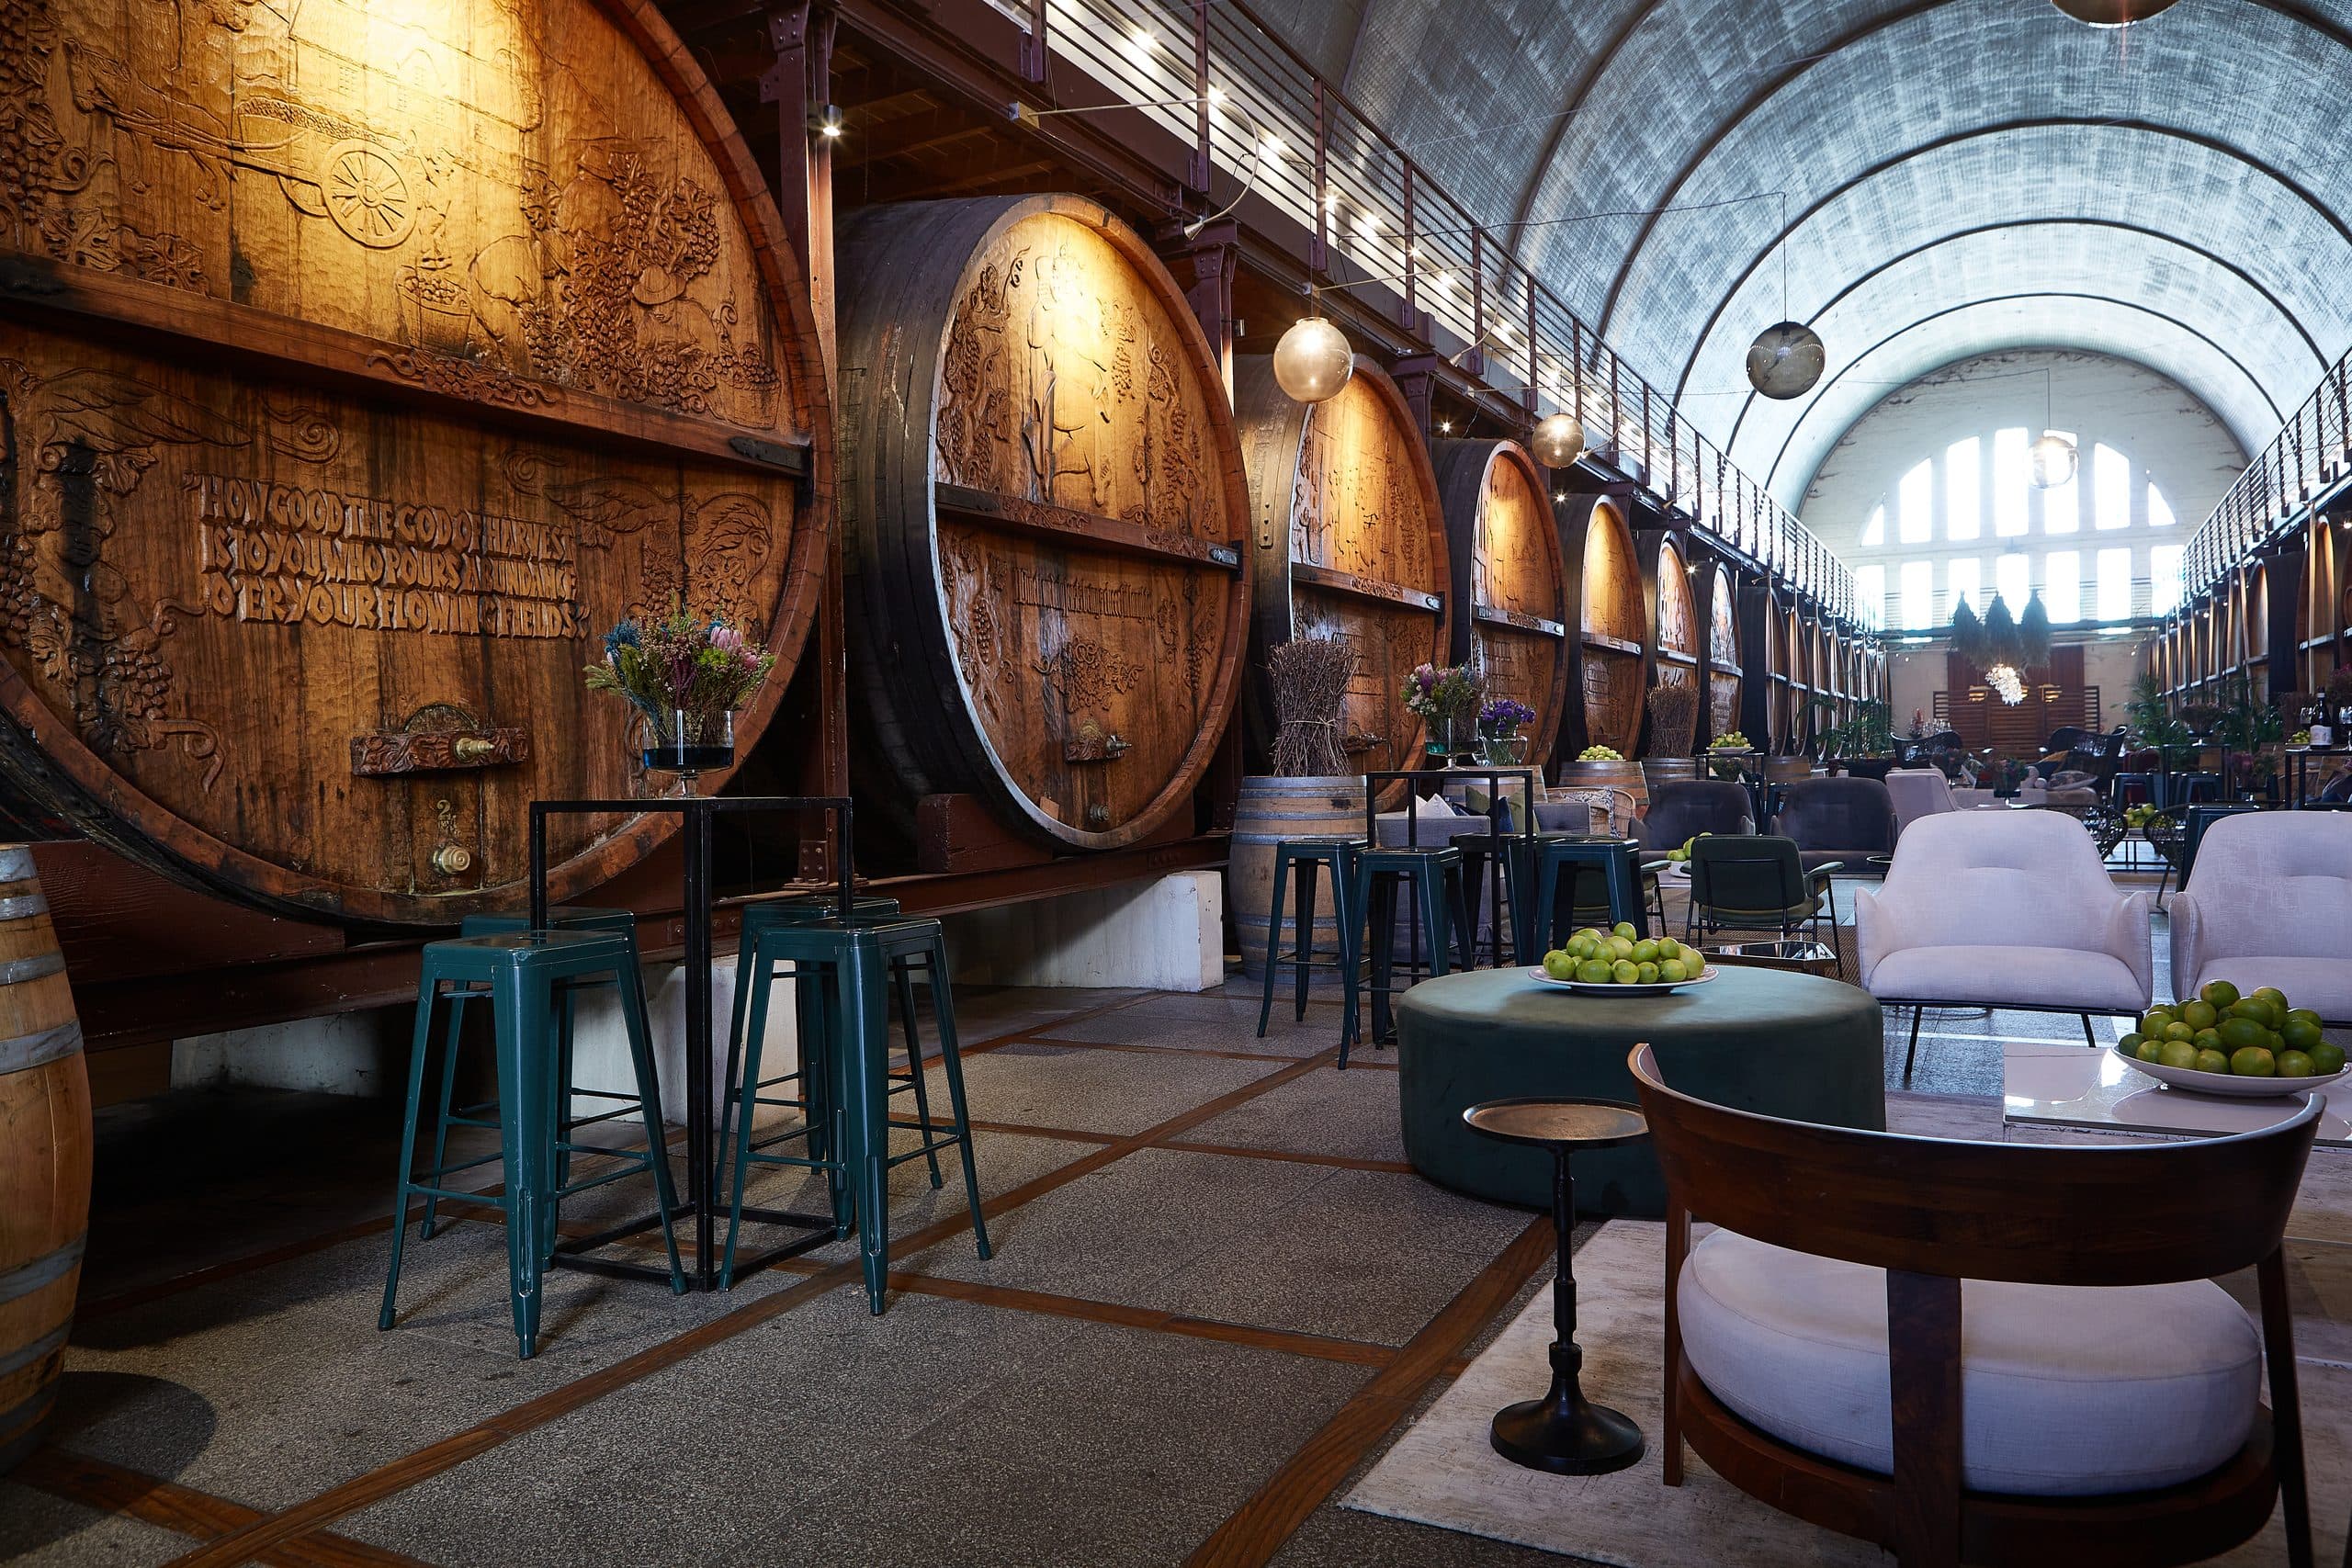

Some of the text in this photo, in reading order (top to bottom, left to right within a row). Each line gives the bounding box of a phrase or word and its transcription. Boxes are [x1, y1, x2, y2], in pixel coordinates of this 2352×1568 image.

[268, 483, 345, 536] GOOD
[342, 493, 396, 542] THE
[395, 504, 453, 552] GOD
[451, 511, 484, 554] OF
[483, 516, 574, 565] HARVEST
[199, 523, 578, 603] IS TO YOU, WHO POURS ABUNDANCE
[210, 570, 287, 624] O'ER
[277, 572, 379, 630] YOUR
[373, 586, 499, 636] FLOWING
[436, 799, 451, 820] 2
